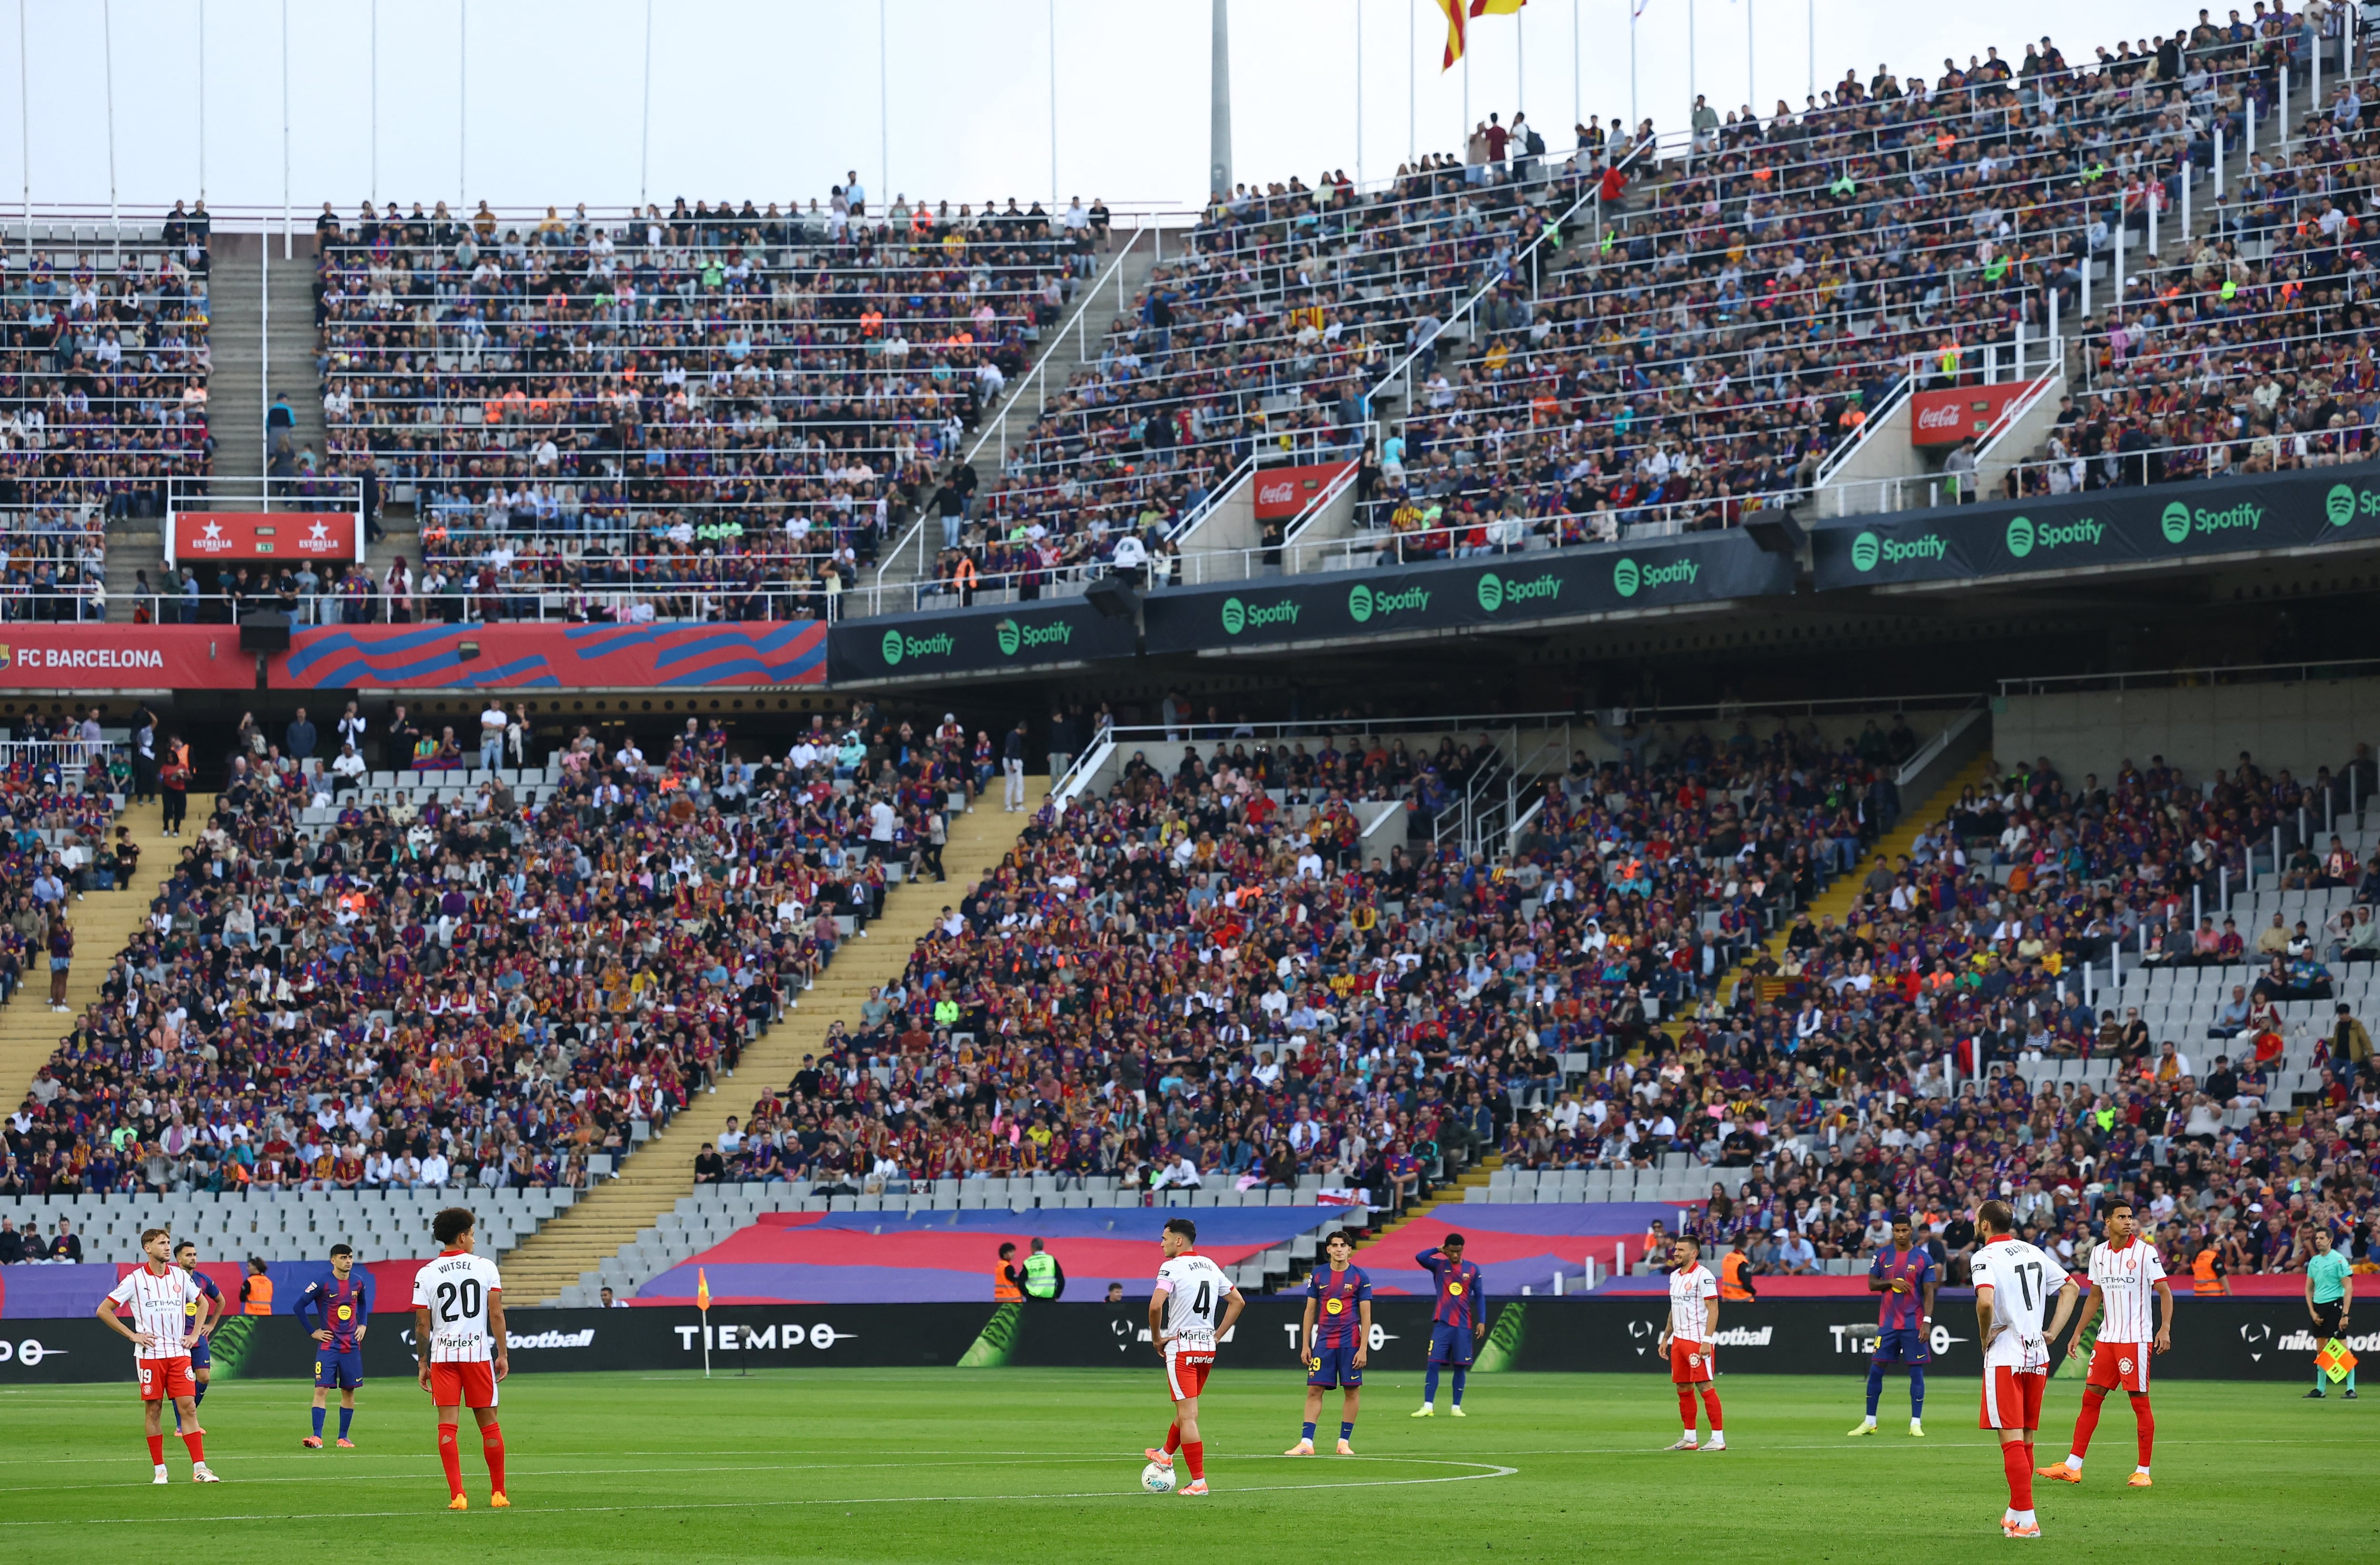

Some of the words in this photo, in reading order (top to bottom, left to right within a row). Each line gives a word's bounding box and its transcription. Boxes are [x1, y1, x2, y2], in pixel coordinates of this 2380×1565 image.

[2194, 502, 2262, 534] Spotify
[192, 539, 232, 548] ESTRELLA
[298, 539, 338, 548] ESTRELLA
[2038, 518, 2104, 548] Spotify
[1882, 534, 1947, 563] Spotify
[1642, 558, 1698, 588] Spotify
[1506, 574, 1562, 603] Spotify
[1376, 586, 1429, 614] Spotify
[1248, 600, 1299, 627] Spotify
[1022, 621, 1071, 647] Spotify
[906, 633, 953, 658] Spotify
[18, 649, 40, 667] FC
[46, 649, 163, 668] BARCELONA
[2005, 1245, 2029, 1256] BLIND
[438, 1261, 472, 1274] WITSEL
[1188, 1261, 1212, 1272] ARNAU
[2014, 1262, 2043, 1311] 17
[436, 1278, 480, 1322] 20
[1193, 1280, 1210, 1319] 4
[439, 1337, 473, 1347] Marlex
[674, 1323, 858, 1350] TIEMPO
[1180, 1331, 1210, 1340] Marlex
[1714, 1326, 1773, 1346] ootball
[1874, 1336, 1882, 1349] 4
[315, 1361, 322, 1374] 8
[1309, 1357, 1321, 1371] 29
[140, 1368, 152, 1384] 19
